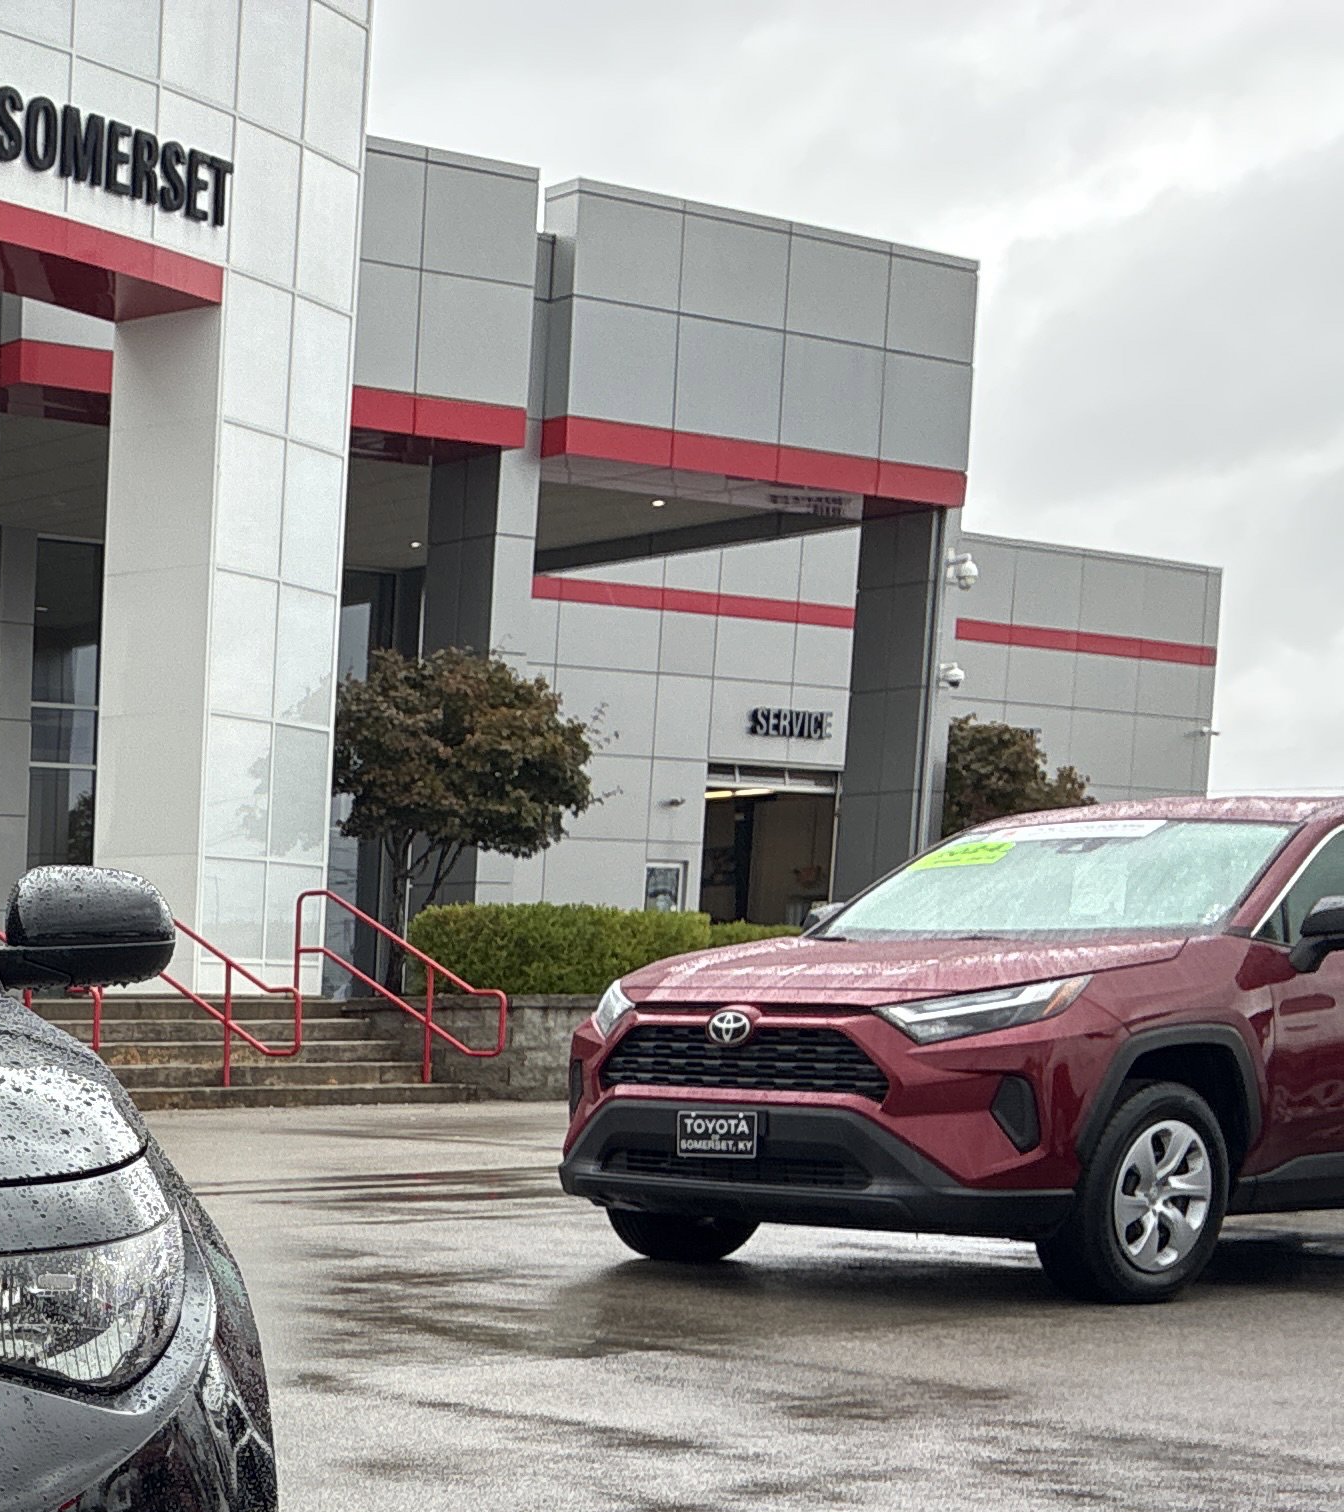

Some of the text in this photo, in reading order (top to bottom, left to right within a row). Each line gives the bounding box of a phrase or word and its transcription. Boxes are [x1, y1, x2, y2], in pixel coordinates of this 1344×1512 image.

[749, 707, 833, 739] SERVICE
[684, 1118, 749, 1135] TOYOTA
[738, 1141, 753, 1152] KY
